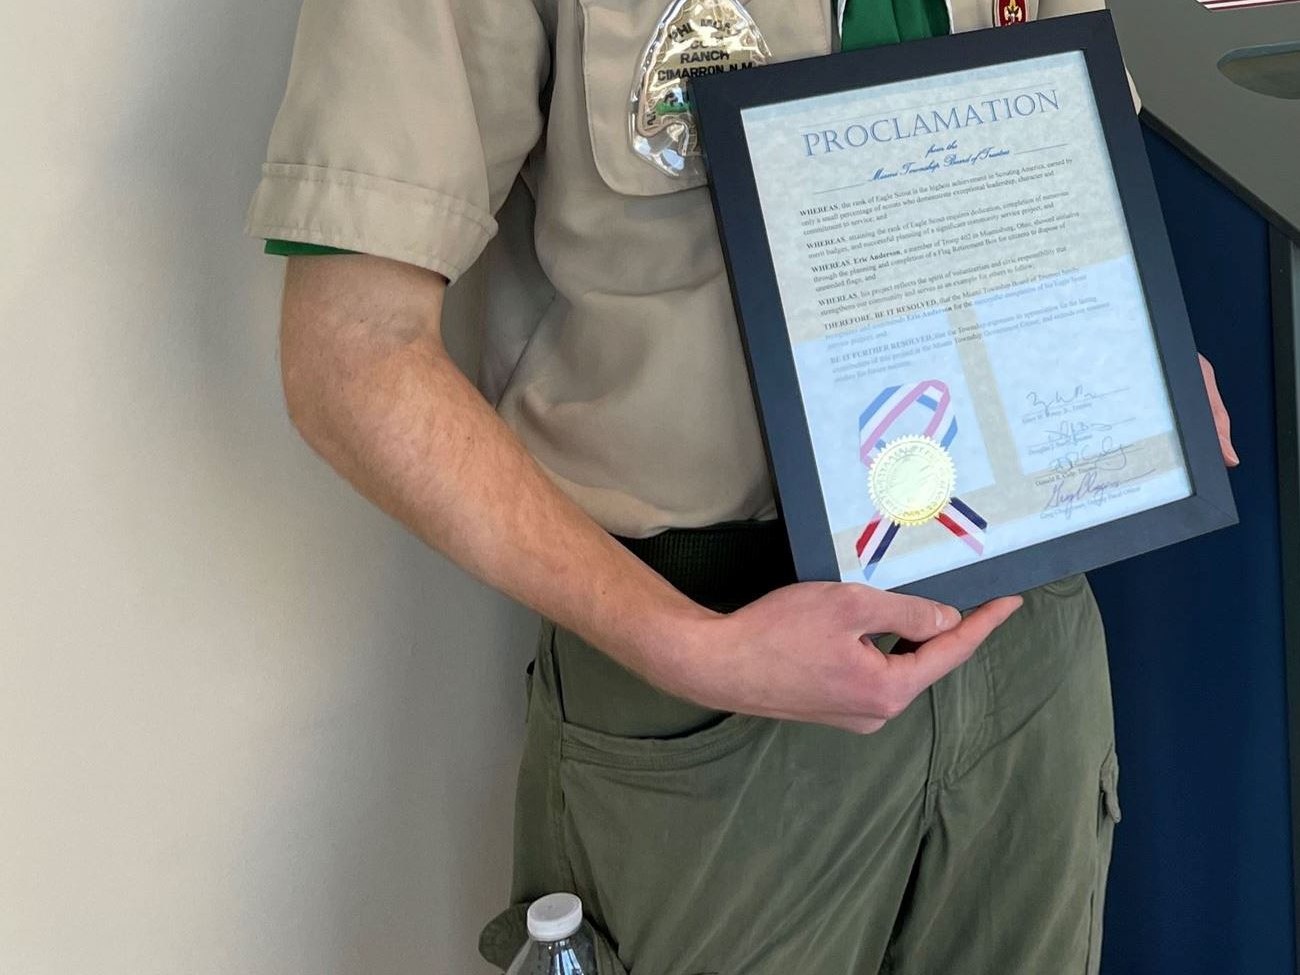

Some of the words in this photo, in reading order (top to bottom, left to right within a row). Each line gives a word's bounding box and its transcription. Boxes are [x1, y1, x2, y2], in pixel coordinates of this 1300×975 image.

[681, 50, 730, 64] RANCH
[802, 89, 1059, 156] PROCLAMATION
[875, 193, 892, 202] Eagle
[852, 256, 867, 264] Eric
